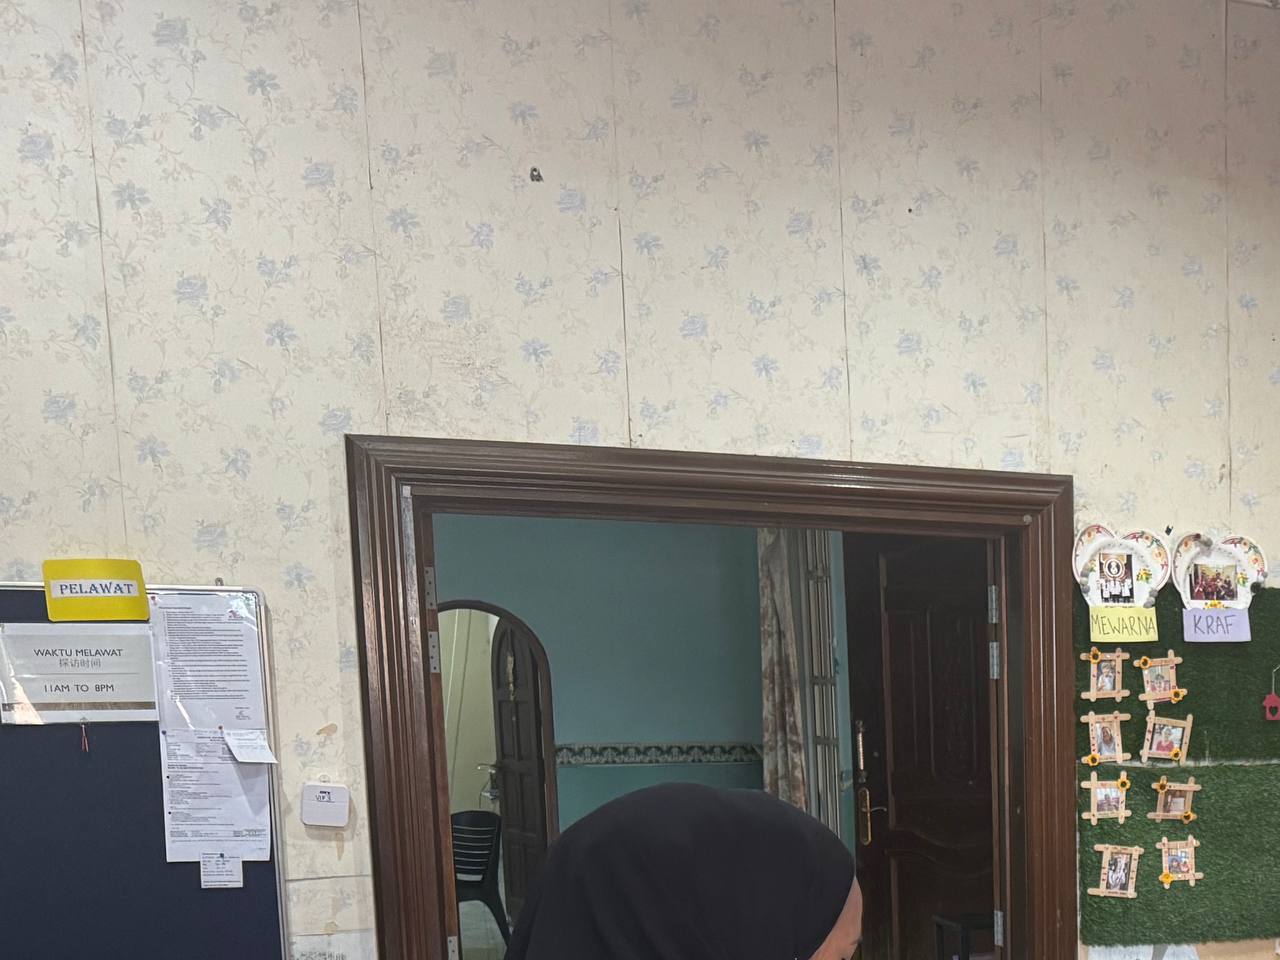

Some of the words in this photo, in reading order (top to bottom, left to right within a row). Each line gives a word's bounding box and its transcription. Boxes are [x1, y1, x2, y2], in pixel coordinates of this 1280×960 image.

[59, 581, 134, 595] PELAWAT
[1090, 614, 1157, 637] MEWARNA
[1192, 614, 1237, 636] KRAF
[33, 648, 73, 657] WAKTU
[75, 648, 124, 657] MELAWAT
[44, 684, 70, 692] 11AM
[74, 684, 89, 692] TO
[95, 683, 115, 692] 8PM
